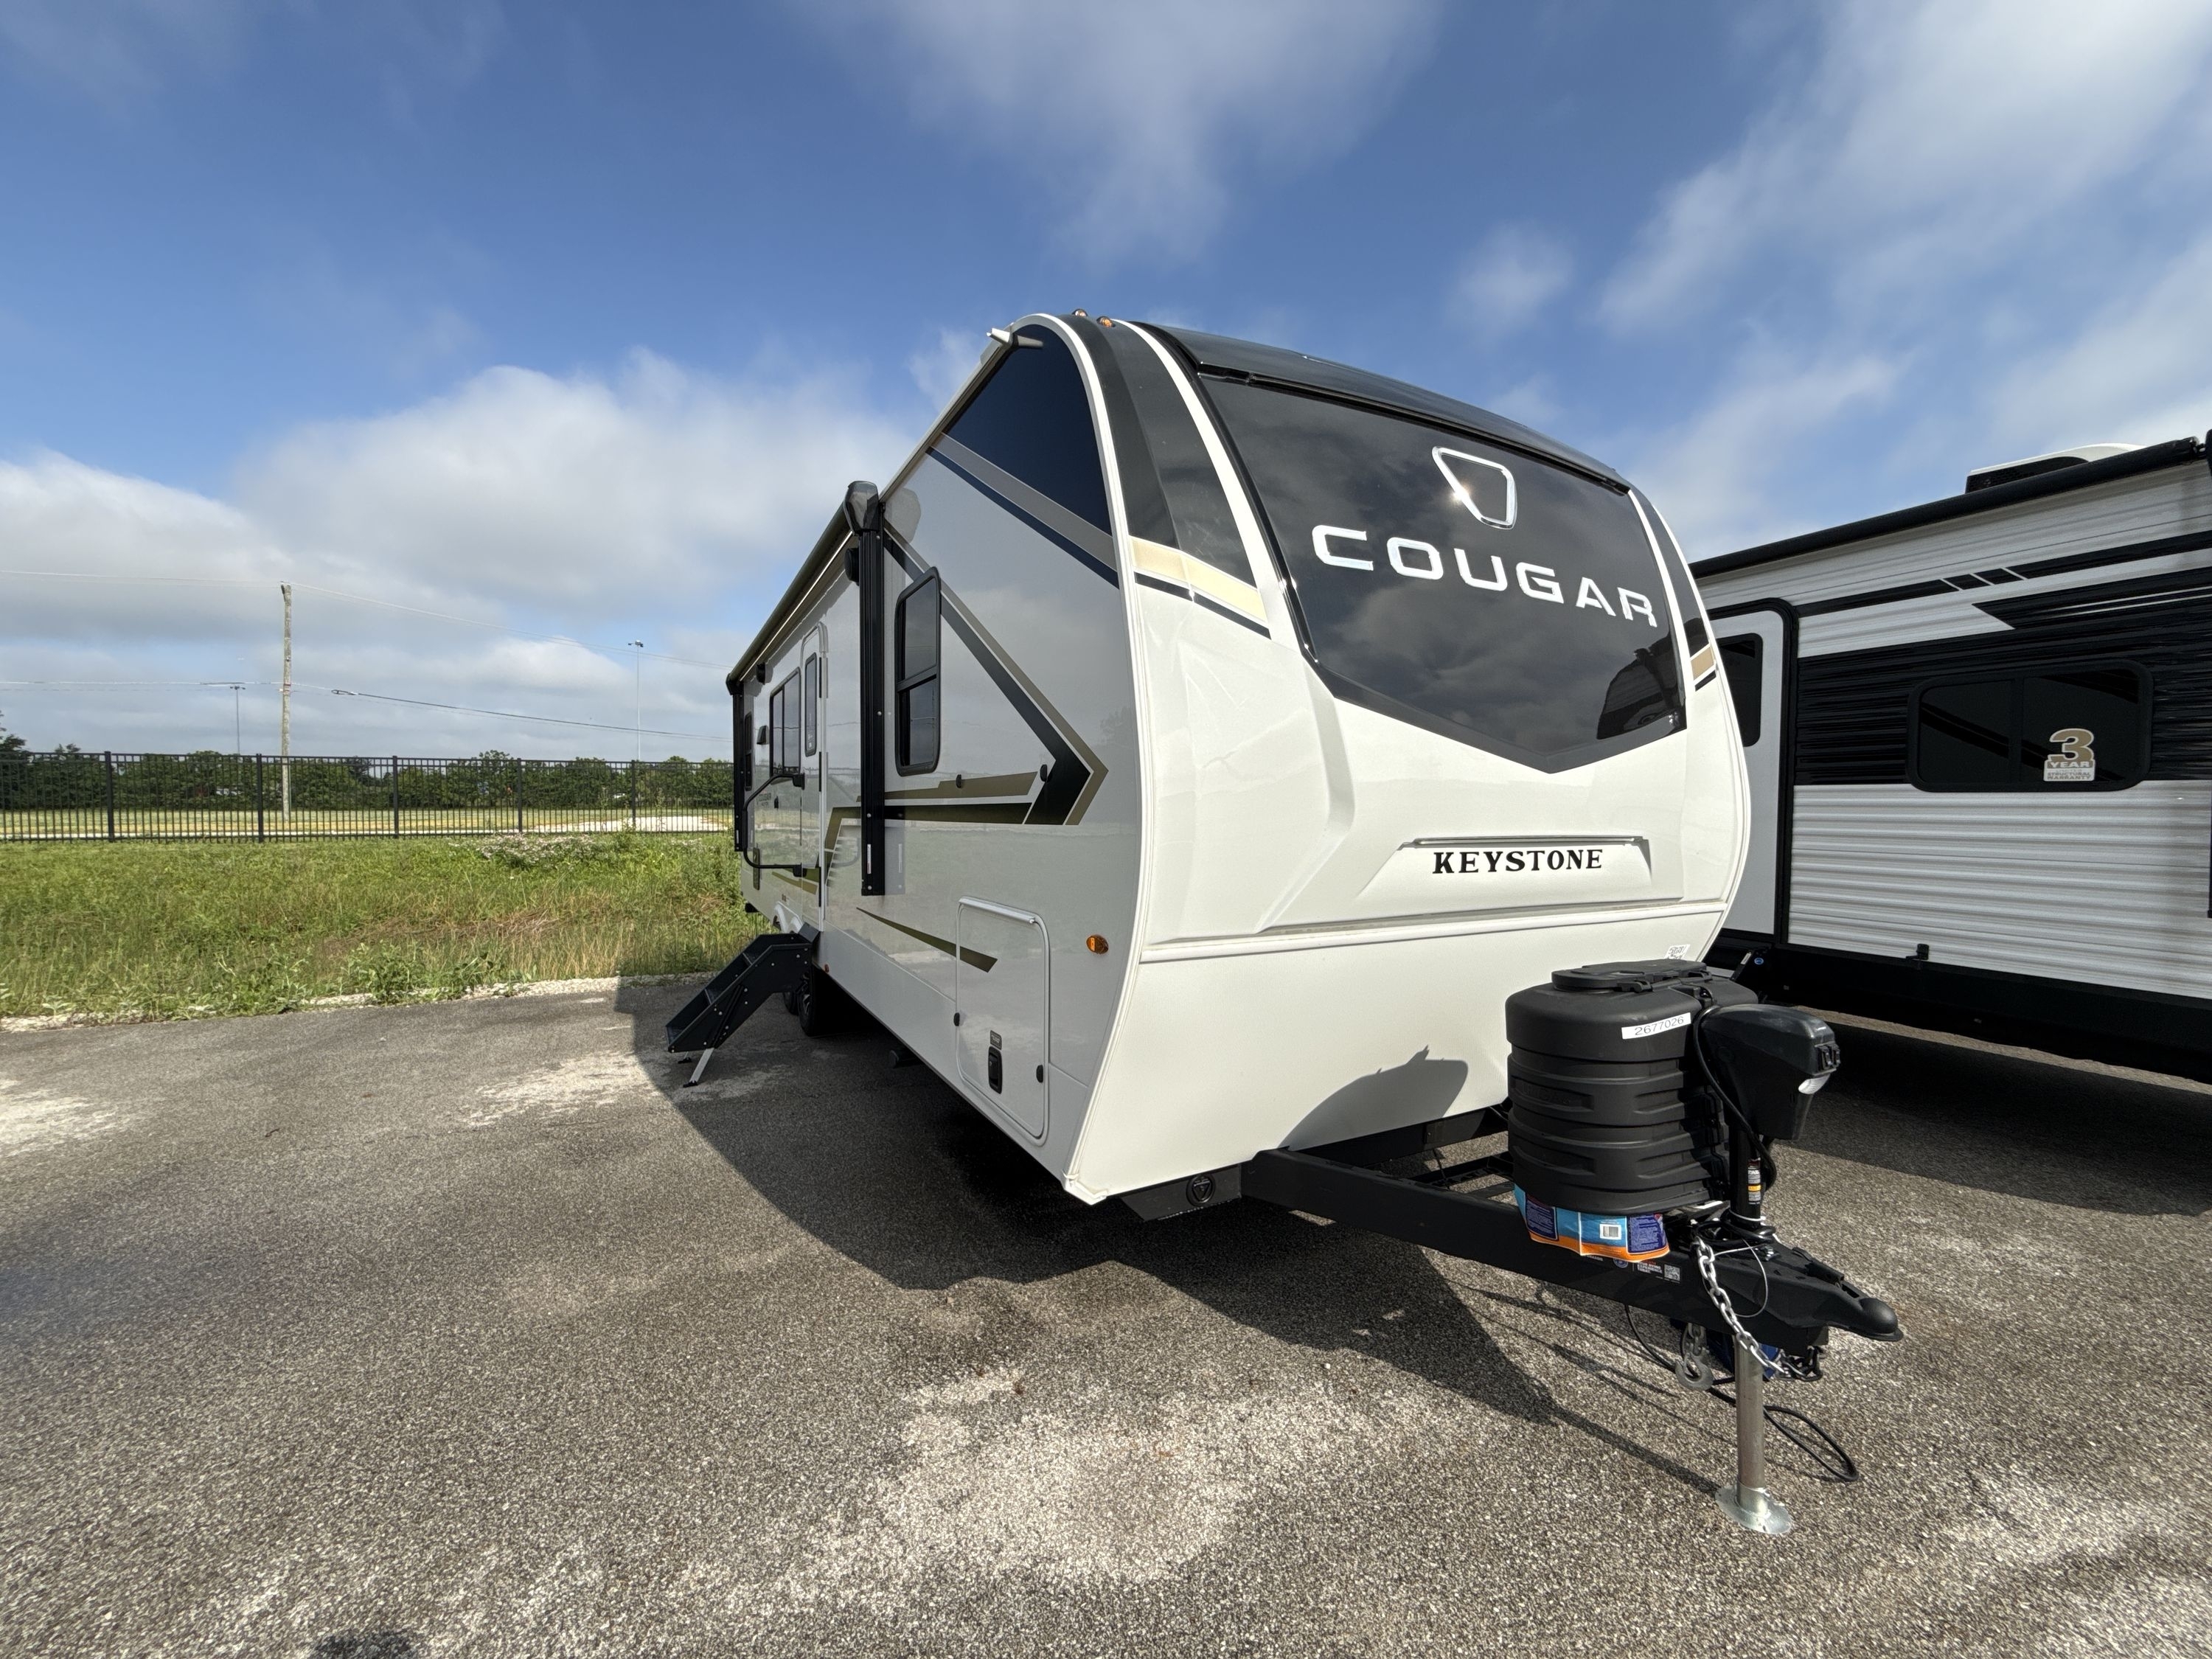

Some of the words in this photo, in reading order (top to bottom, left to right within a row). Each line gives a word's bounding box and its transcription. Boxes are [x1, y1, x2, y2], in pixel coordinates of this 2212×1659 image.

[1312, 524, 1658, 627] COUGAR
[2048, 728, 2094, 762] 3
[1432, 849, 1604, 874] KEYSTONE
[1634, 1016, 1684, 1036] 2677026
